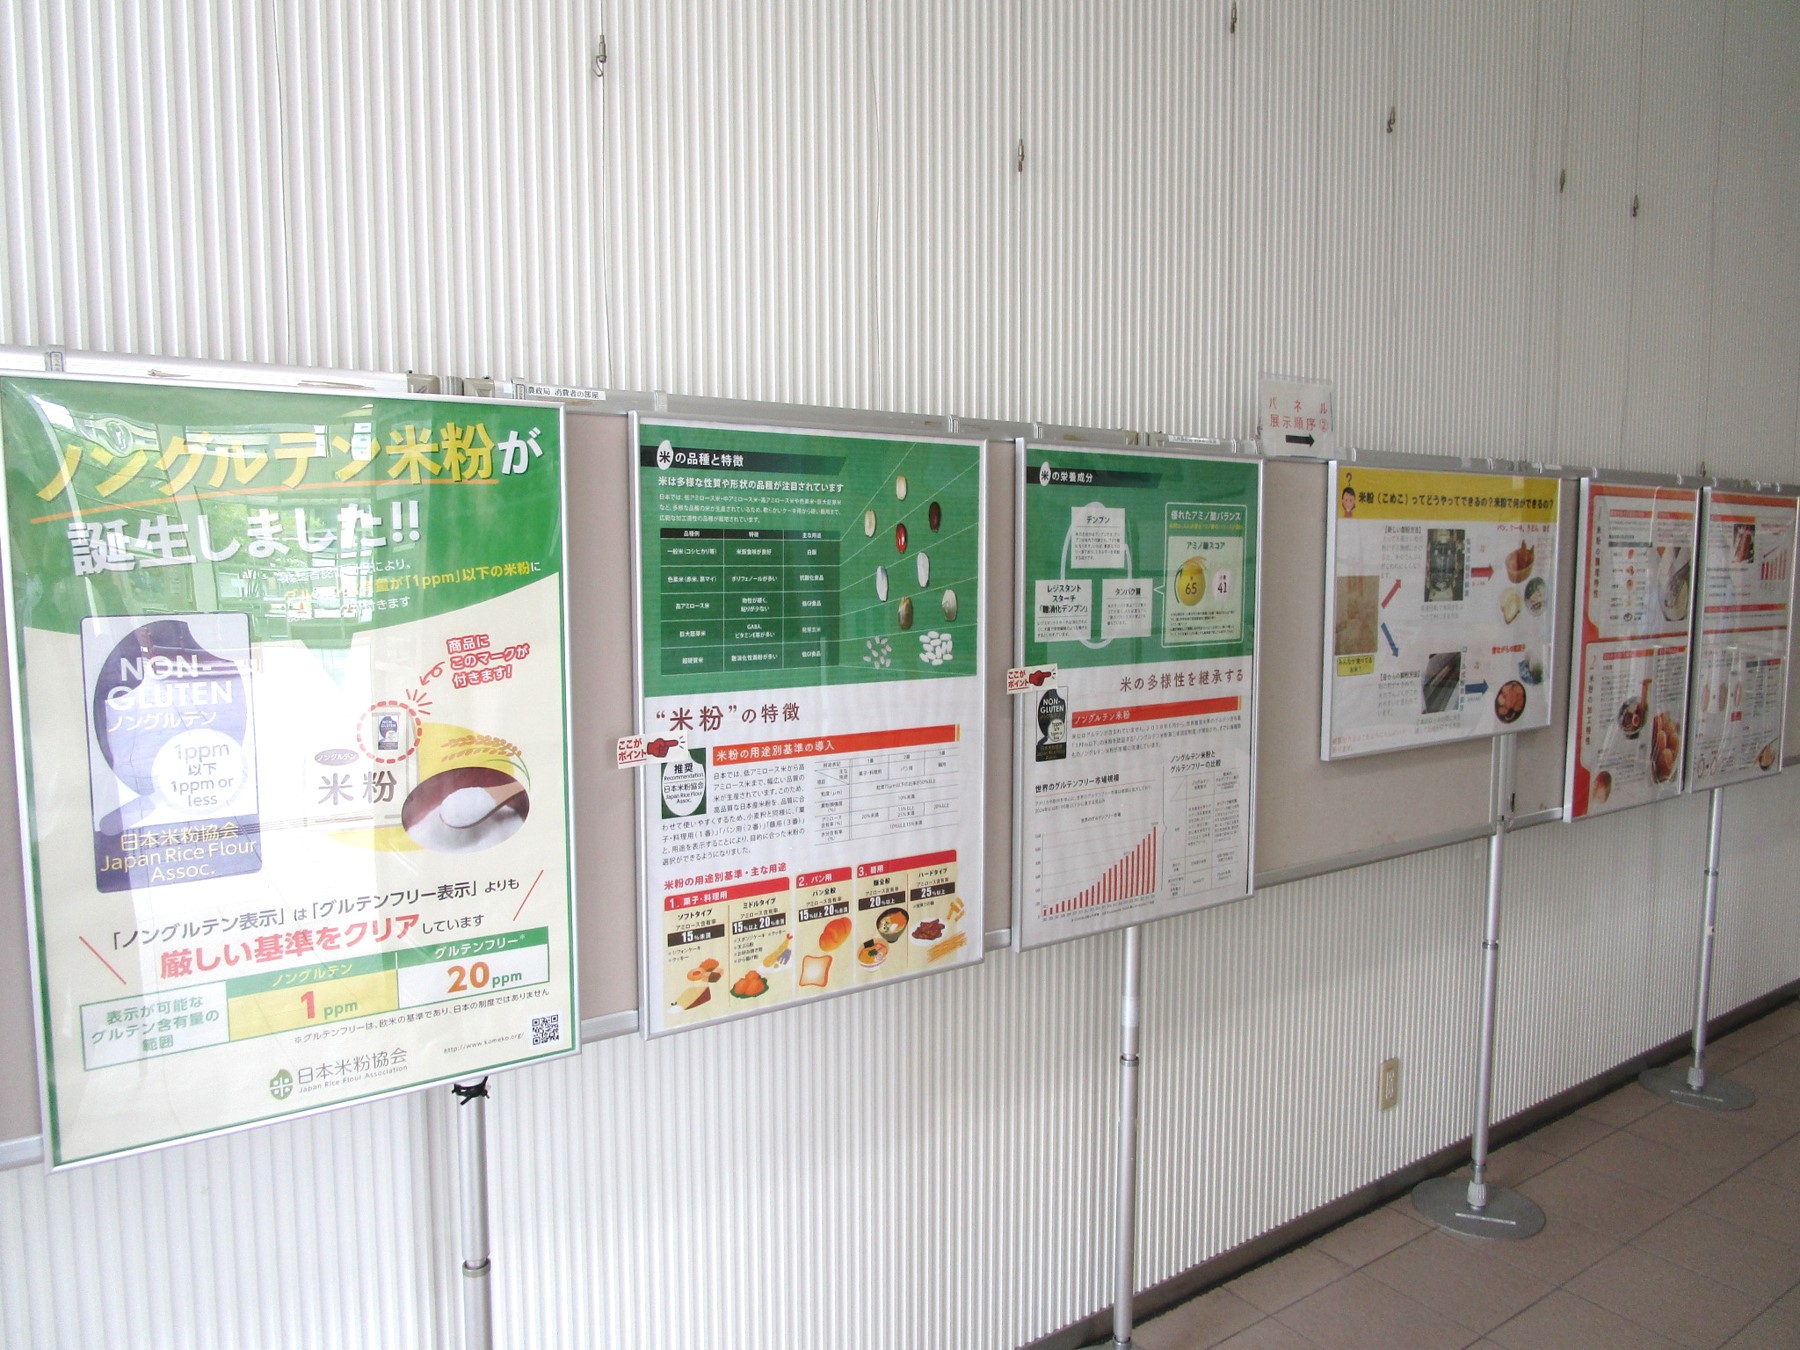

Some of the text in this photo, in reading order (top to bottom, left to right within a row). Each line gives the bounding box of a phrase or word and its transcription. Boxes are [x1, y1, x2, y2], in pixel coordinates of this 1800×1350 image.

[36, 421, 544, 502] ノングルテン米粉が
[658, 449, 744, 468] 米の品種と特徴
[1040, 469, 1094, 483] 米の栄養成分
[1185, 582, 1228, 595] 65 41
[446, 634, 490, 654] 商品に
[120, 654, 212, 682] NON-
[450, 643, 531, 671] このマークが
[452, 664, 513, 690] 付きます!
[1120, 668, 1244, 693] 米の多様性を継承する
[106, 680, 233, 711] GLUTEN
[1039, 704, 1064, 714] GLUTEN
[1074, 712, 1131, 725] ノングルテン米粉
[108, 711, 217, 733] ノングルテン
[174, 744, 231, 763] 1ppm
[618, 737, 643, 751] ここが
[618, 748, 647, 762] ポイント
[716, 742, 835, 762] 米粉の用途別基準の導入
[188, 762, 217, 776] 以下
[171, 777, 234, 796] 1ppm or
[318, 770, 397, 806] 米粉
[188, 794, 218, 807] less
[120, 821, 240, 852] 日本米粉協会
[101, 838, 257, 873] Japan Rice Flour
[151, 863, 216, 883] Assoc.
[663, 862, 788, 891] 米粉の用途別基準・主な用途
[743, 897, 776, 909] ミドルタイプ
[677, 908, 713, 921] ソフトタイプ
[271, 963, 353, 988] ノングルテン
[446, 961, 523, 994] 20 ppm
[106, 995, 204, 1025] 表示が可能な
[300, 990, 358, 1020] 1 ppm
[91, 1008, 220, 1045] グルテン含有量の
[142, 1034, 174, 1052] 範囲
[298, 1047, 408, 1085] 日本米粉協会
[299, 1065, 408, 1095] Japan Rice Flour Association
